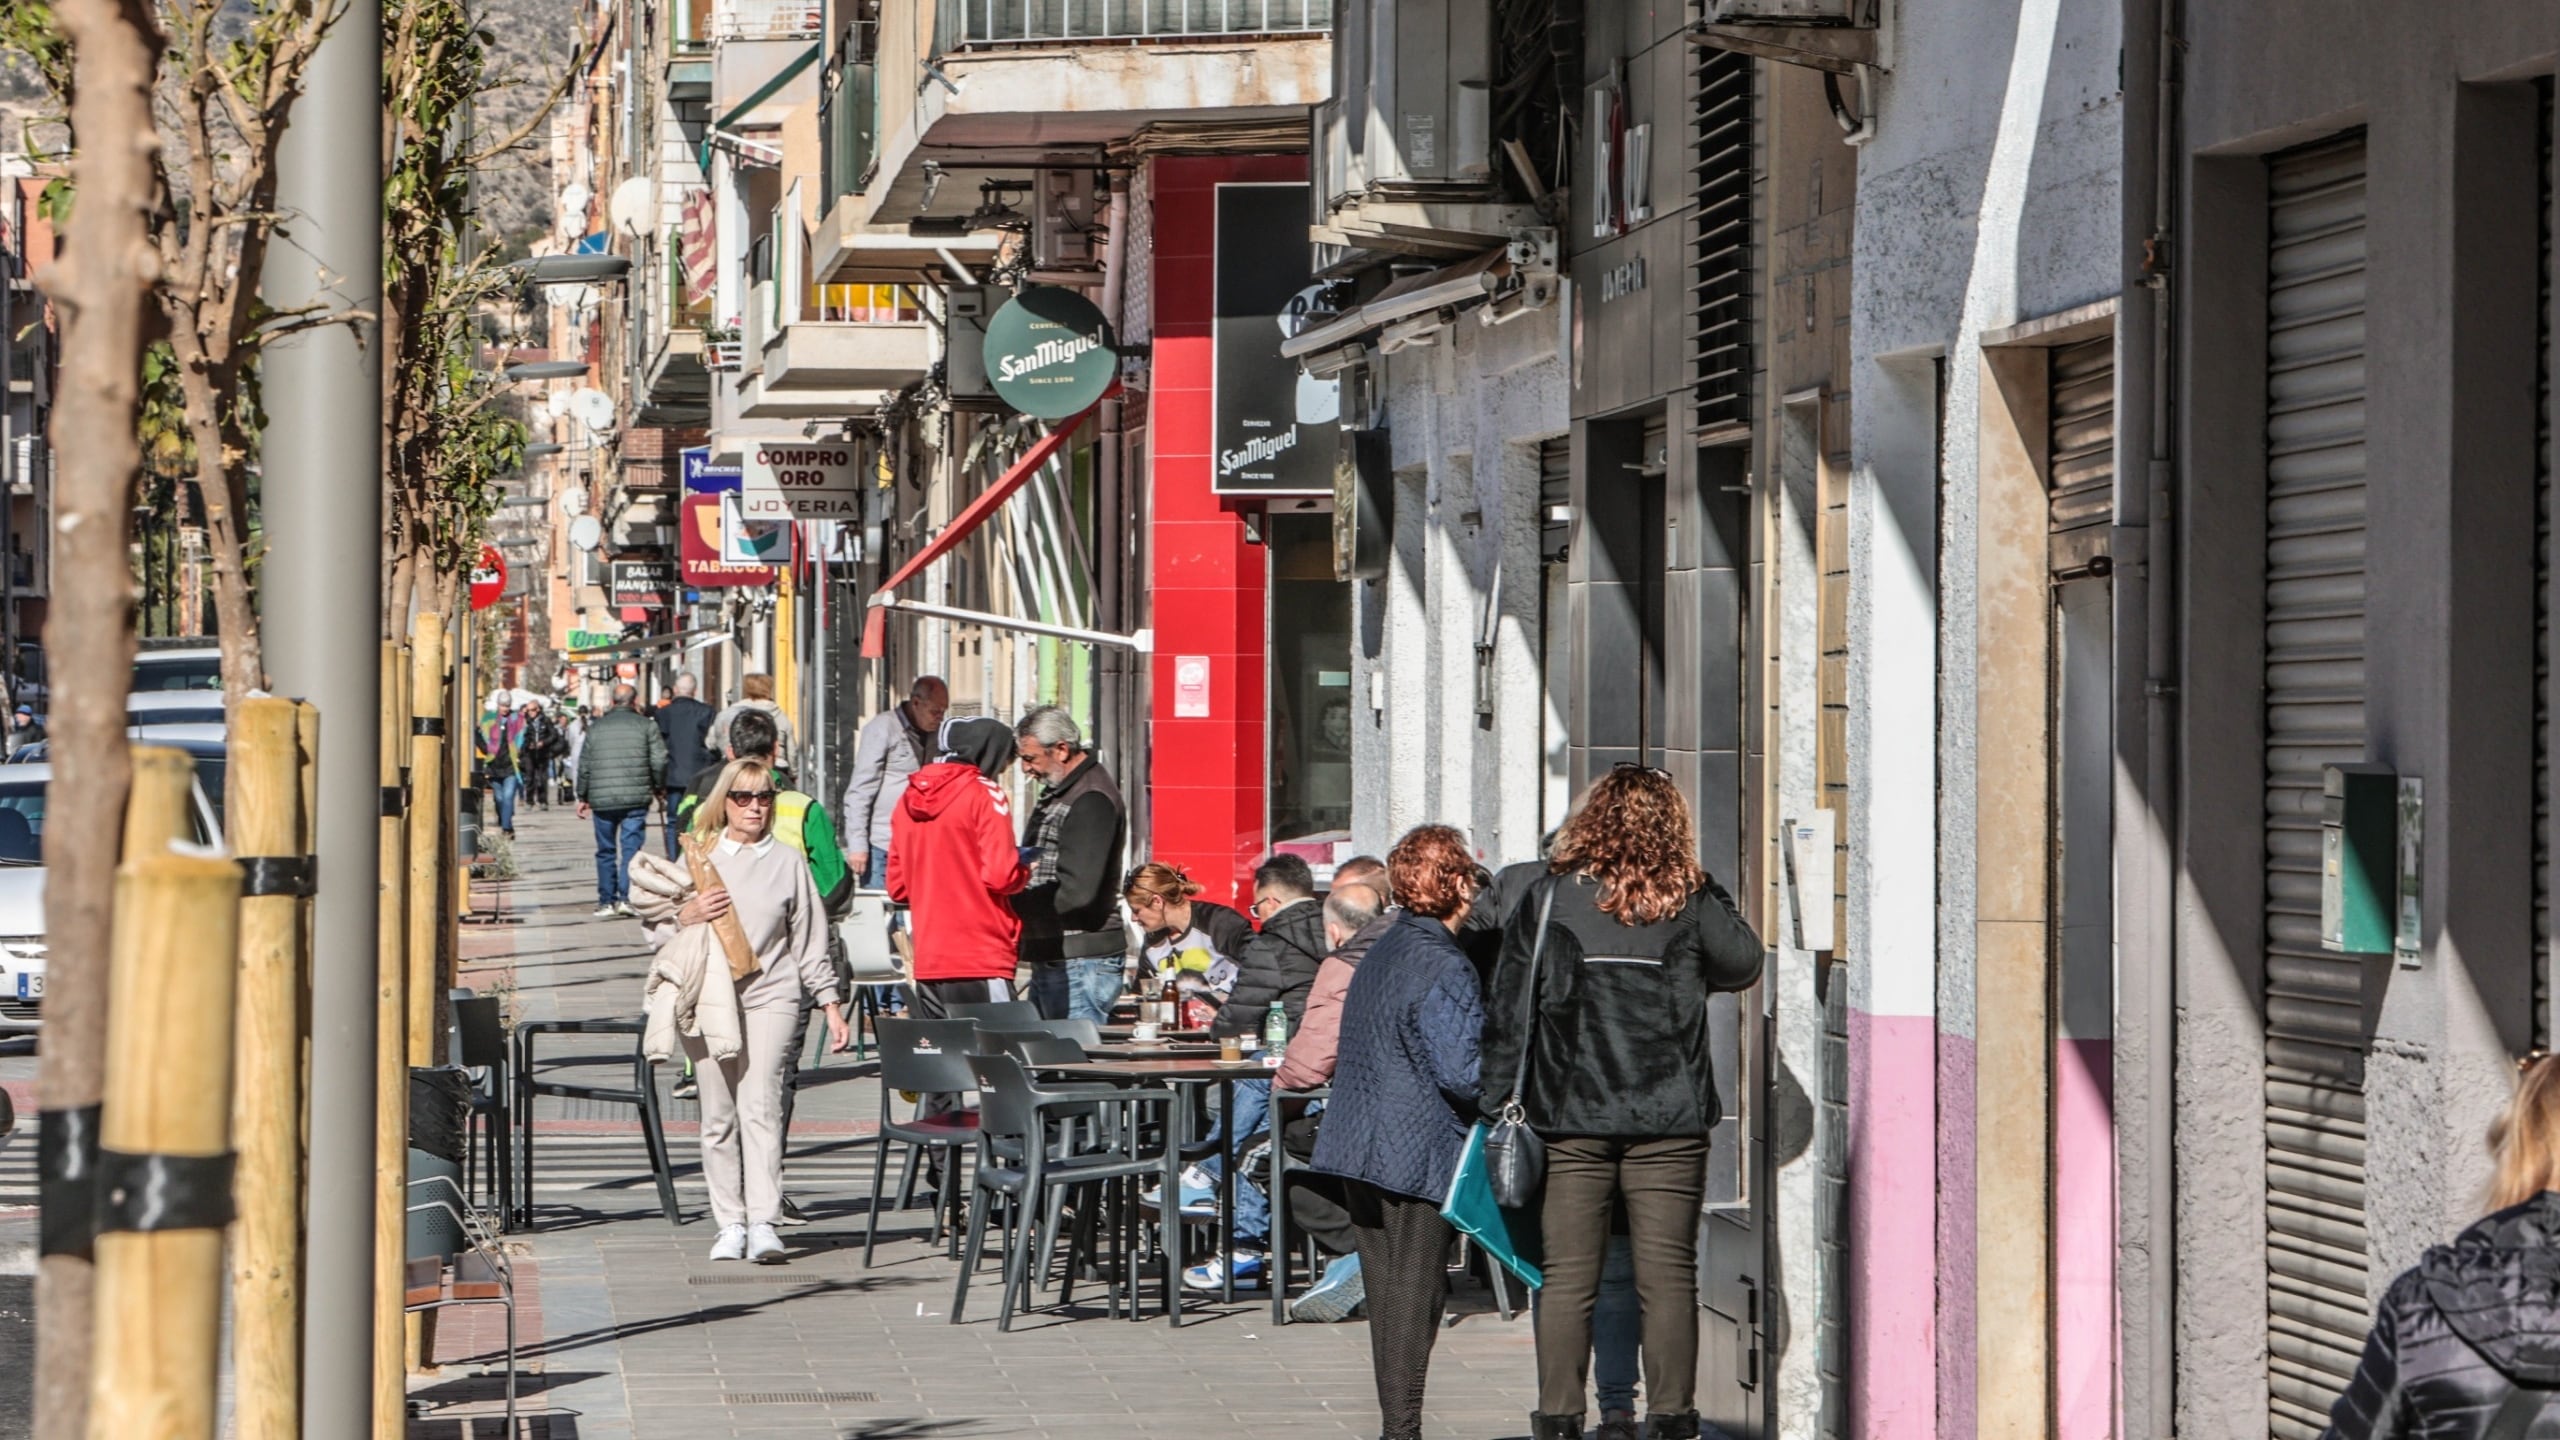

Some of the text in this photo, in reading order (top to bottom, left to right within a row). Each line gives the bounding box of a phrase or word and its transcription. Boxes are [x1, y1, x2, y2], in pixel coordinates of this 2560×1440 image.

[756, 450, 849, 466] COMPRO
[703, 465, 743, 473] MICHEL
[780, 470, 825, 486] ORO
[749, 500, 854, 513] JOYERIA
